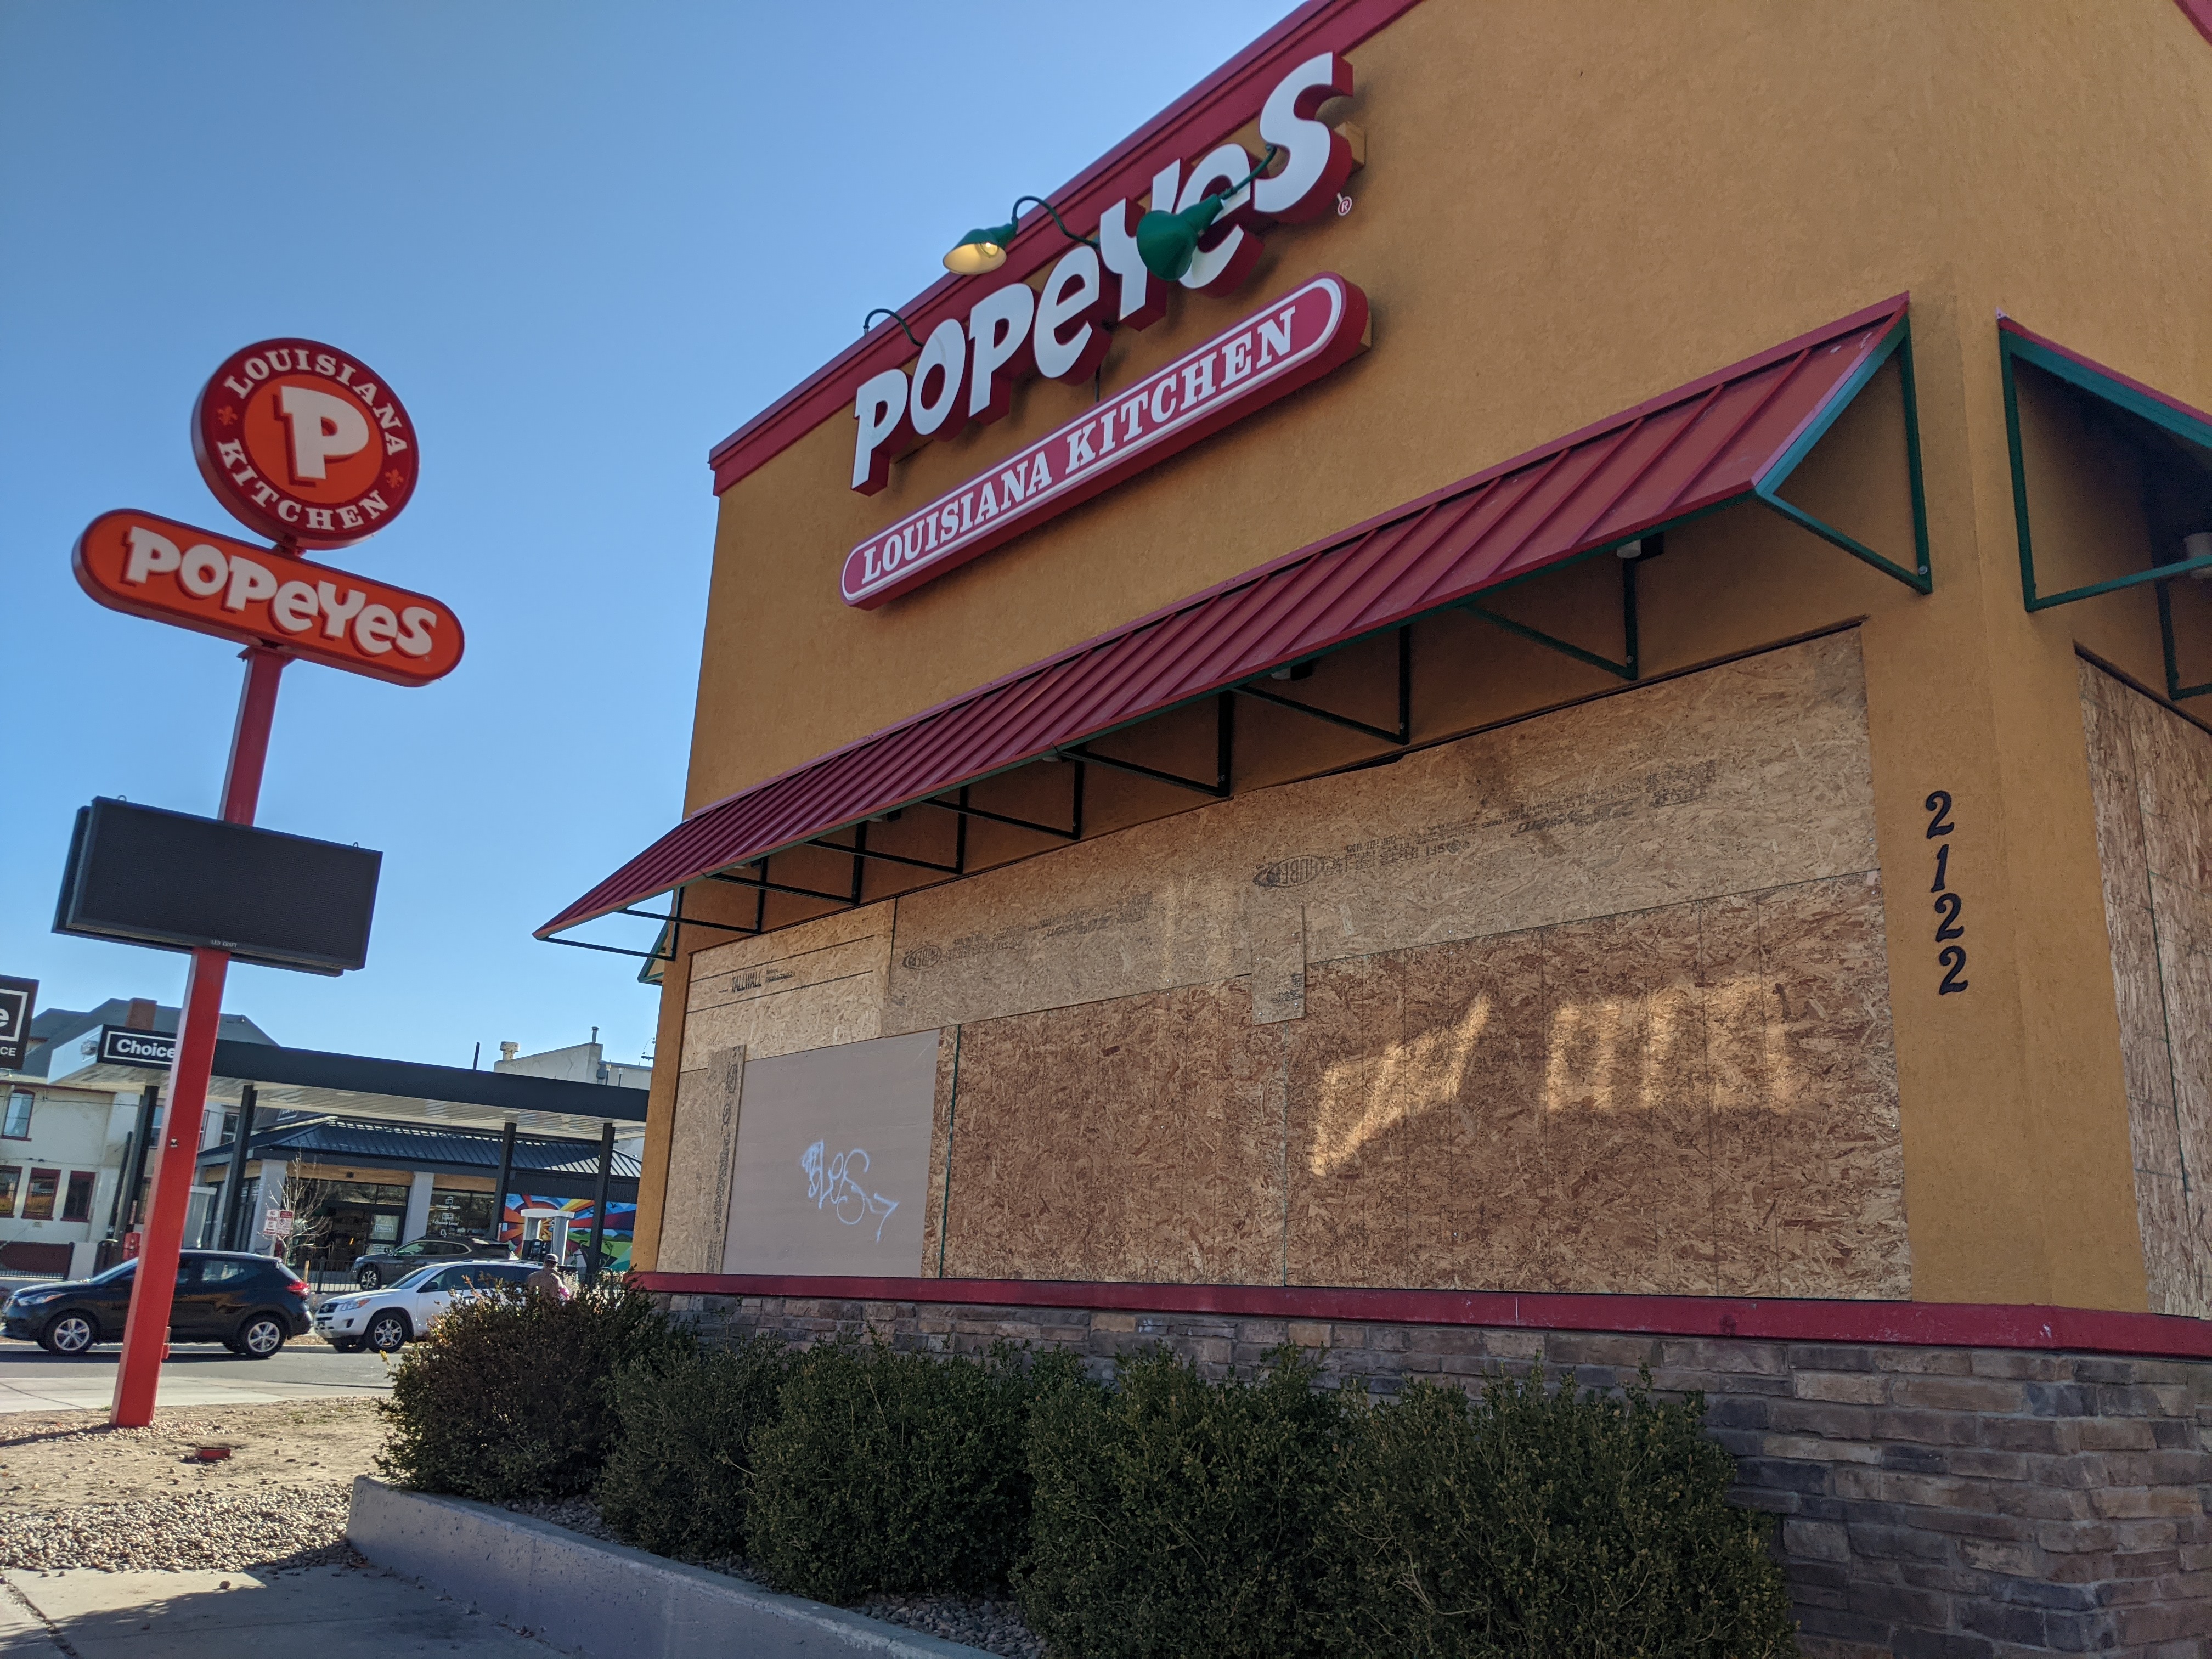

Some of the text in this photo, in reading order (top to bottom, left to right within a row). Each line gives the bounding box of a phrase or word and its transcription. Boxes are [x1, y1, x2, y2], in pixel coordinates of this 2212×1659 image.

[224, 348, 408, 456] LOUISIANA
[280, 385, 369, 479] P
[861, 306, 1296, 585] LOUISIANA KITCHEN
[219, 438, 390, 531] KITCHEN
[1925, 790, 1969, 996] 2122
[116, 1039, 176, 1058] Choice
